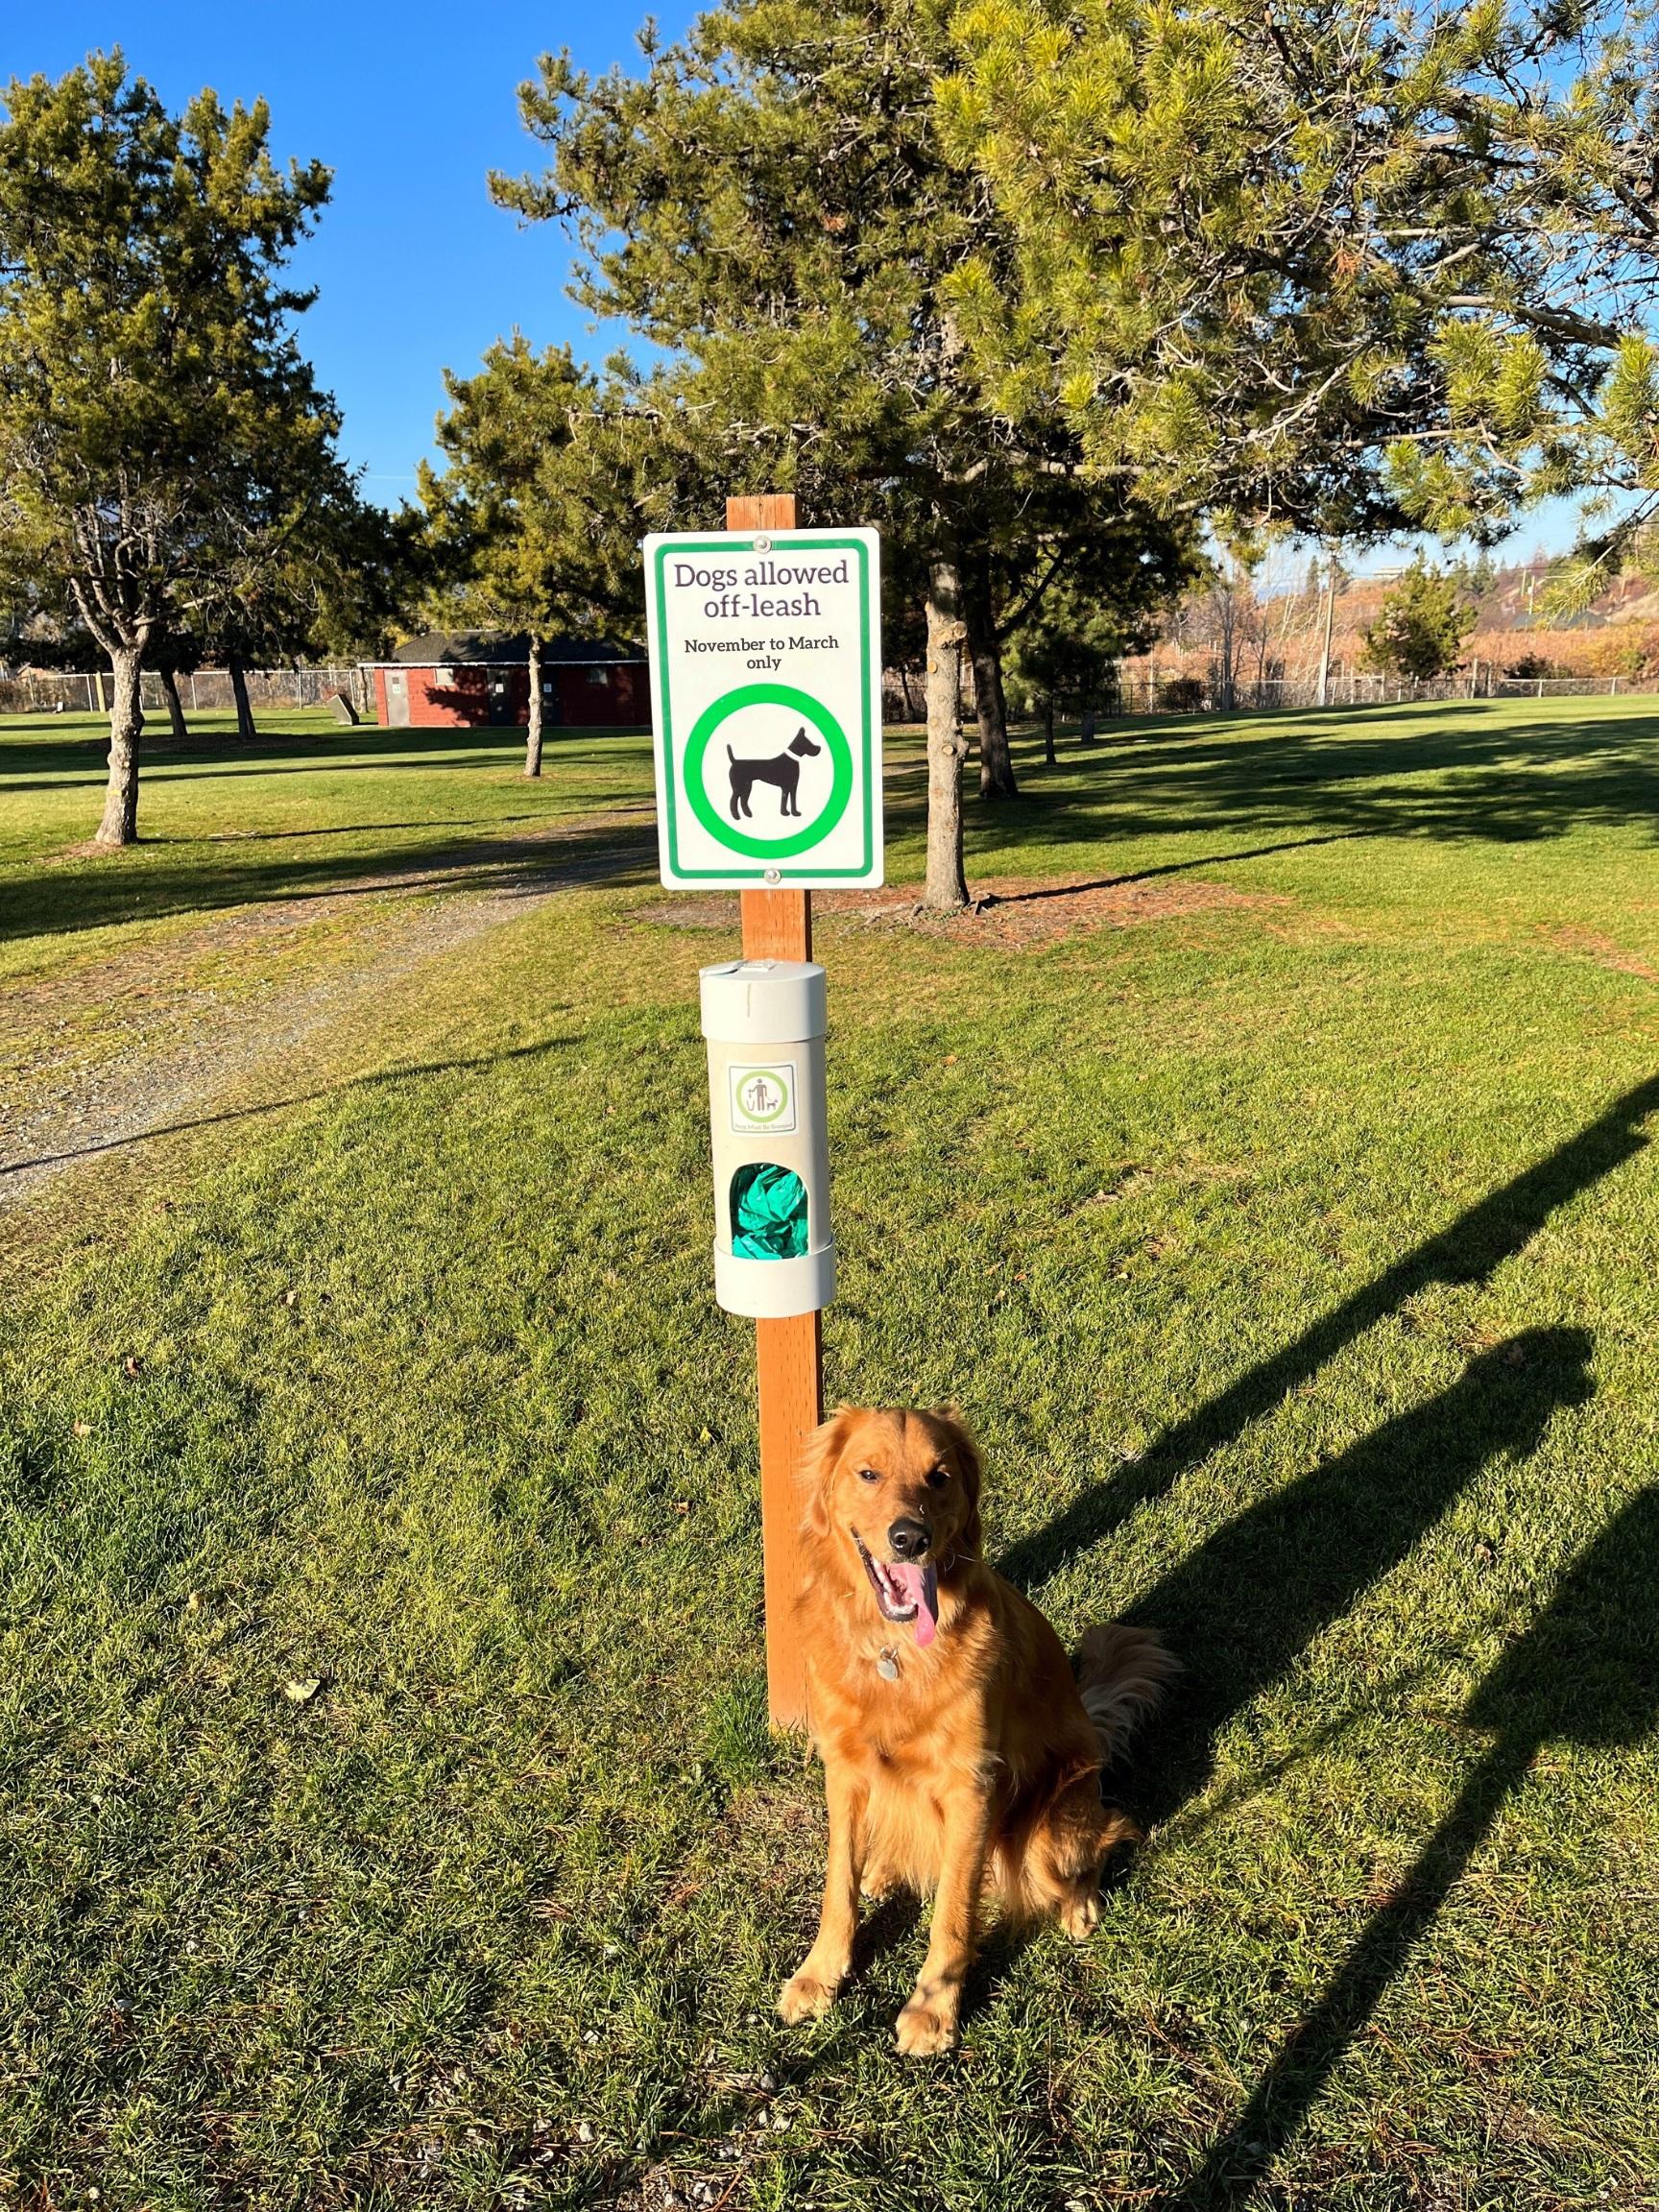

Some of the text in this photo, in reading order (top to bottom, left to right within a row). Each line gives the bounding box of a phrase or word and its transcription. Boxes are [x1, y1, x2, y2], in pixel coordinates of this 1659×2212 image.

[674, 560, 850, 591] Dogs allowed
[704, 592, 821, 617] off-leash
[685, 636, 839, 653] November to March
[746, 656, 781, 671] only
